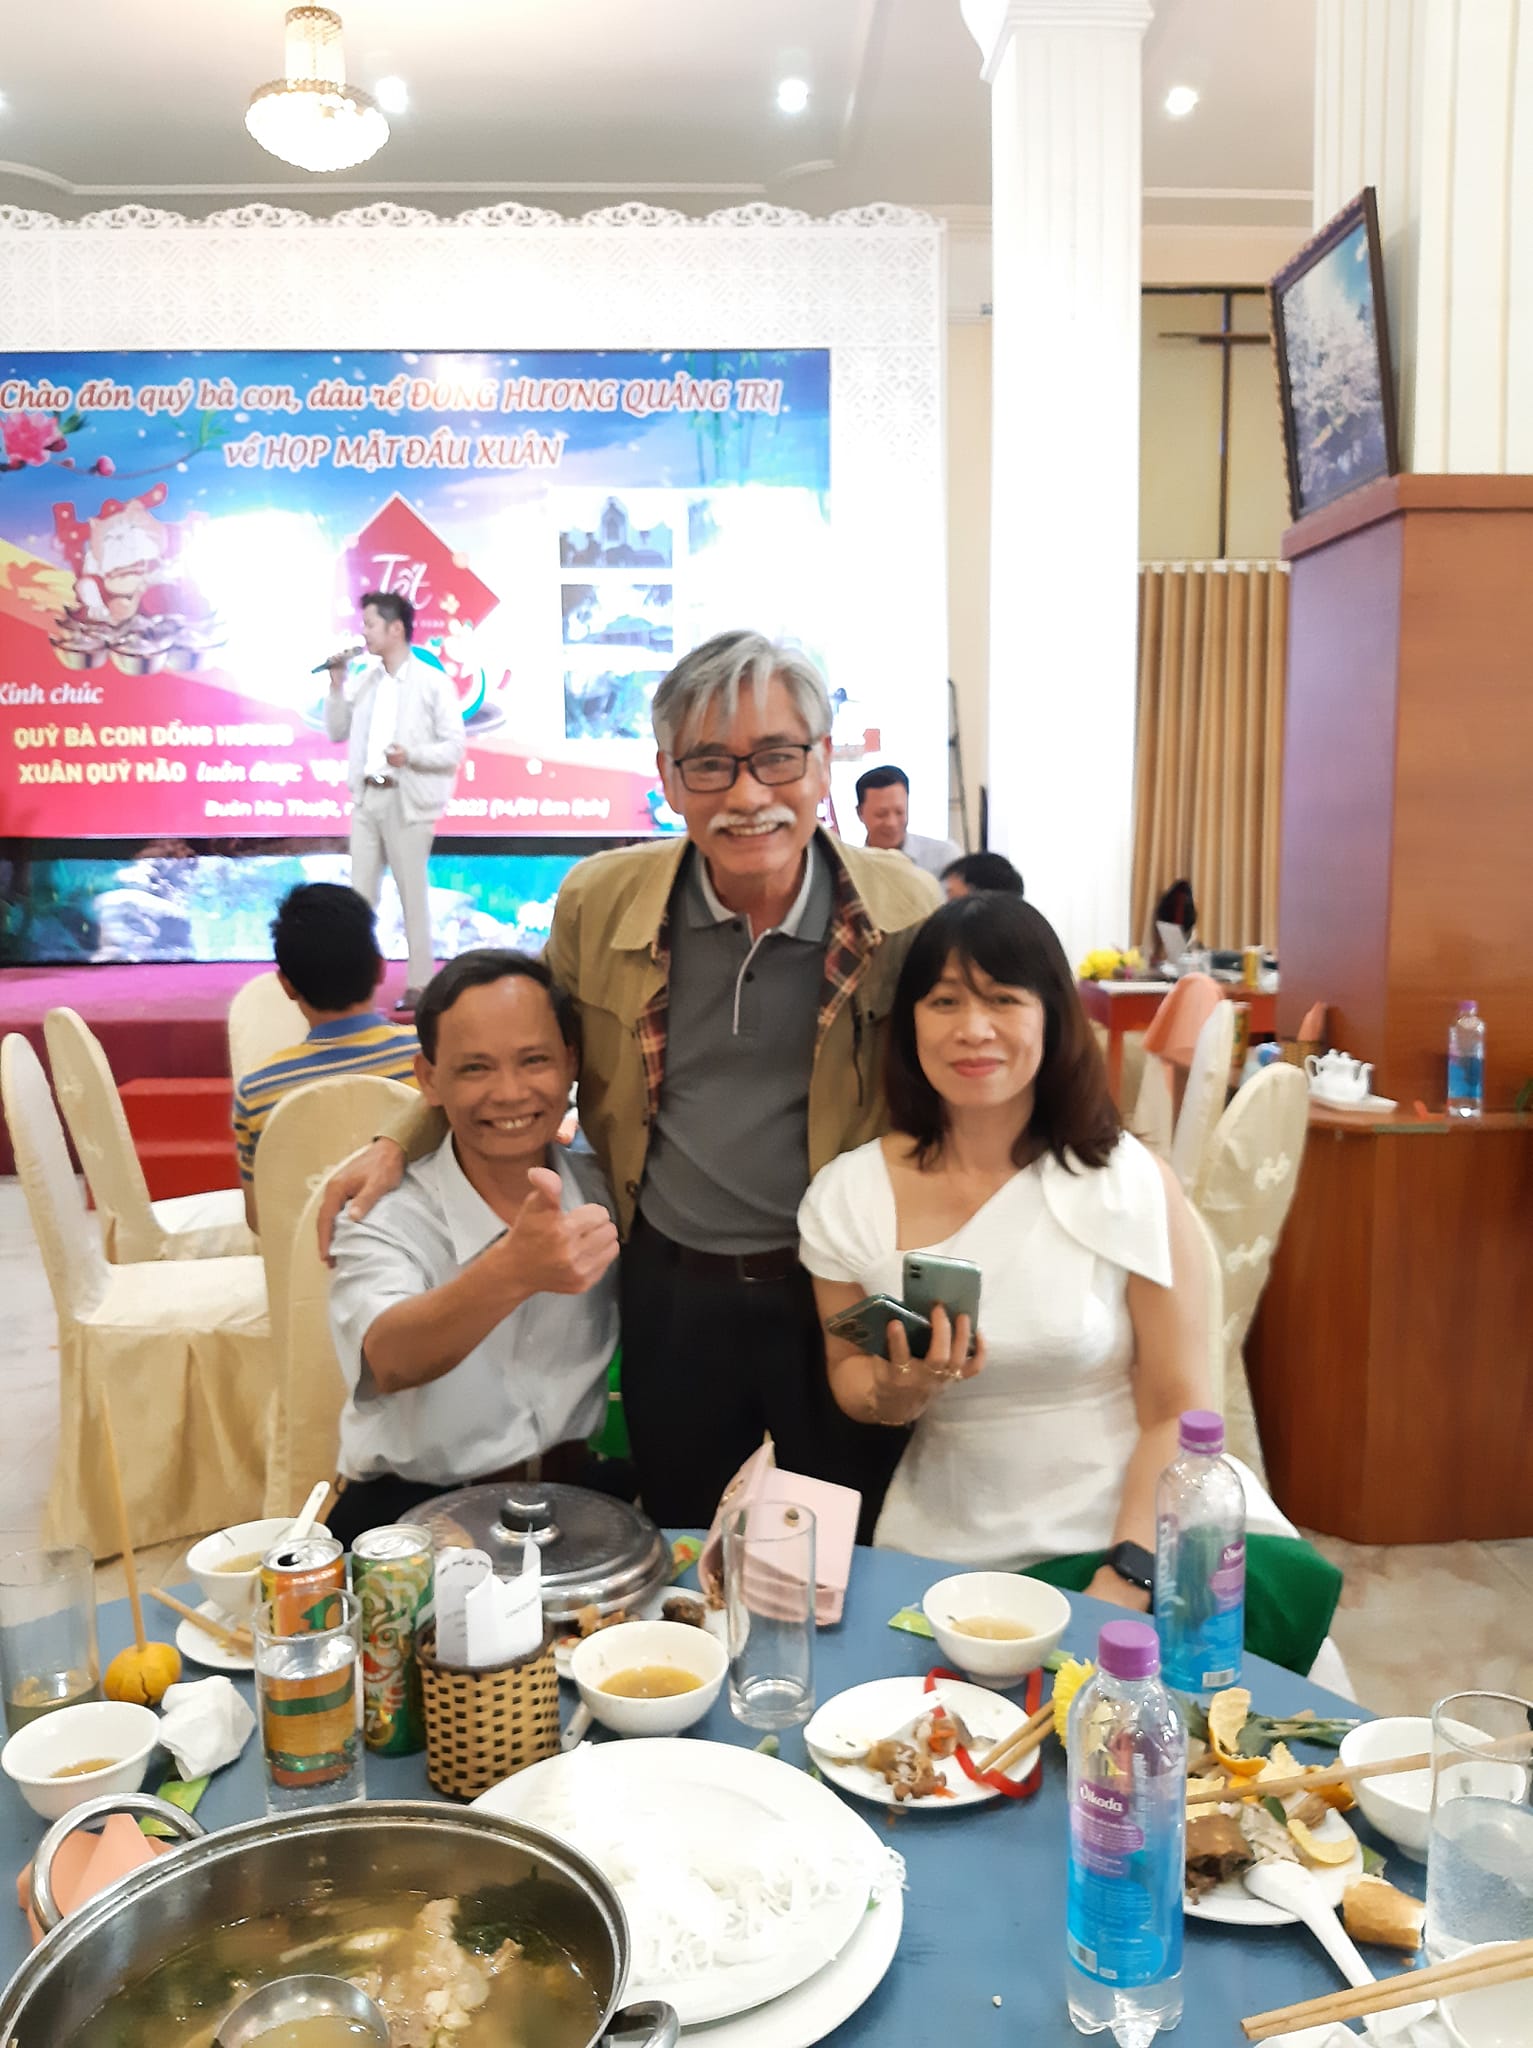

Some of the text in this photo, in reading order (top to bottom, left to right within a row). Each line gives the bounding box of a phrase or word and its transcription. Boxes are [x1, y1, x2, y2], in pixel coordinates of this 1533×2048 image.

[0, 380, 71, 411] Chào
[77, 379, 133, 409] đón
[137, 378, 194, 416] quý
[199, 378, 236, 410] bà
[241, 385, 300, 413] con,
[307, 377, 366, 410] dâu
[502, 377, 617, 412] HƯƠNG
[623, 371, 731, 417] QUẢNG
[735, 378, 783, 415] TRỊ
[263, 432, 330, 471] HỌP
[334, 430, 403, 472] MẶT
[475, 430, 563, 468] XUÂN
[50, 681, 104, 704] chúc
[64, 722, 97, 747] BÀ
[100, 726, 147, 747] CON
[18, 759, 83, 784] XUÂN
[136, 758, 187, 783] MÃO
